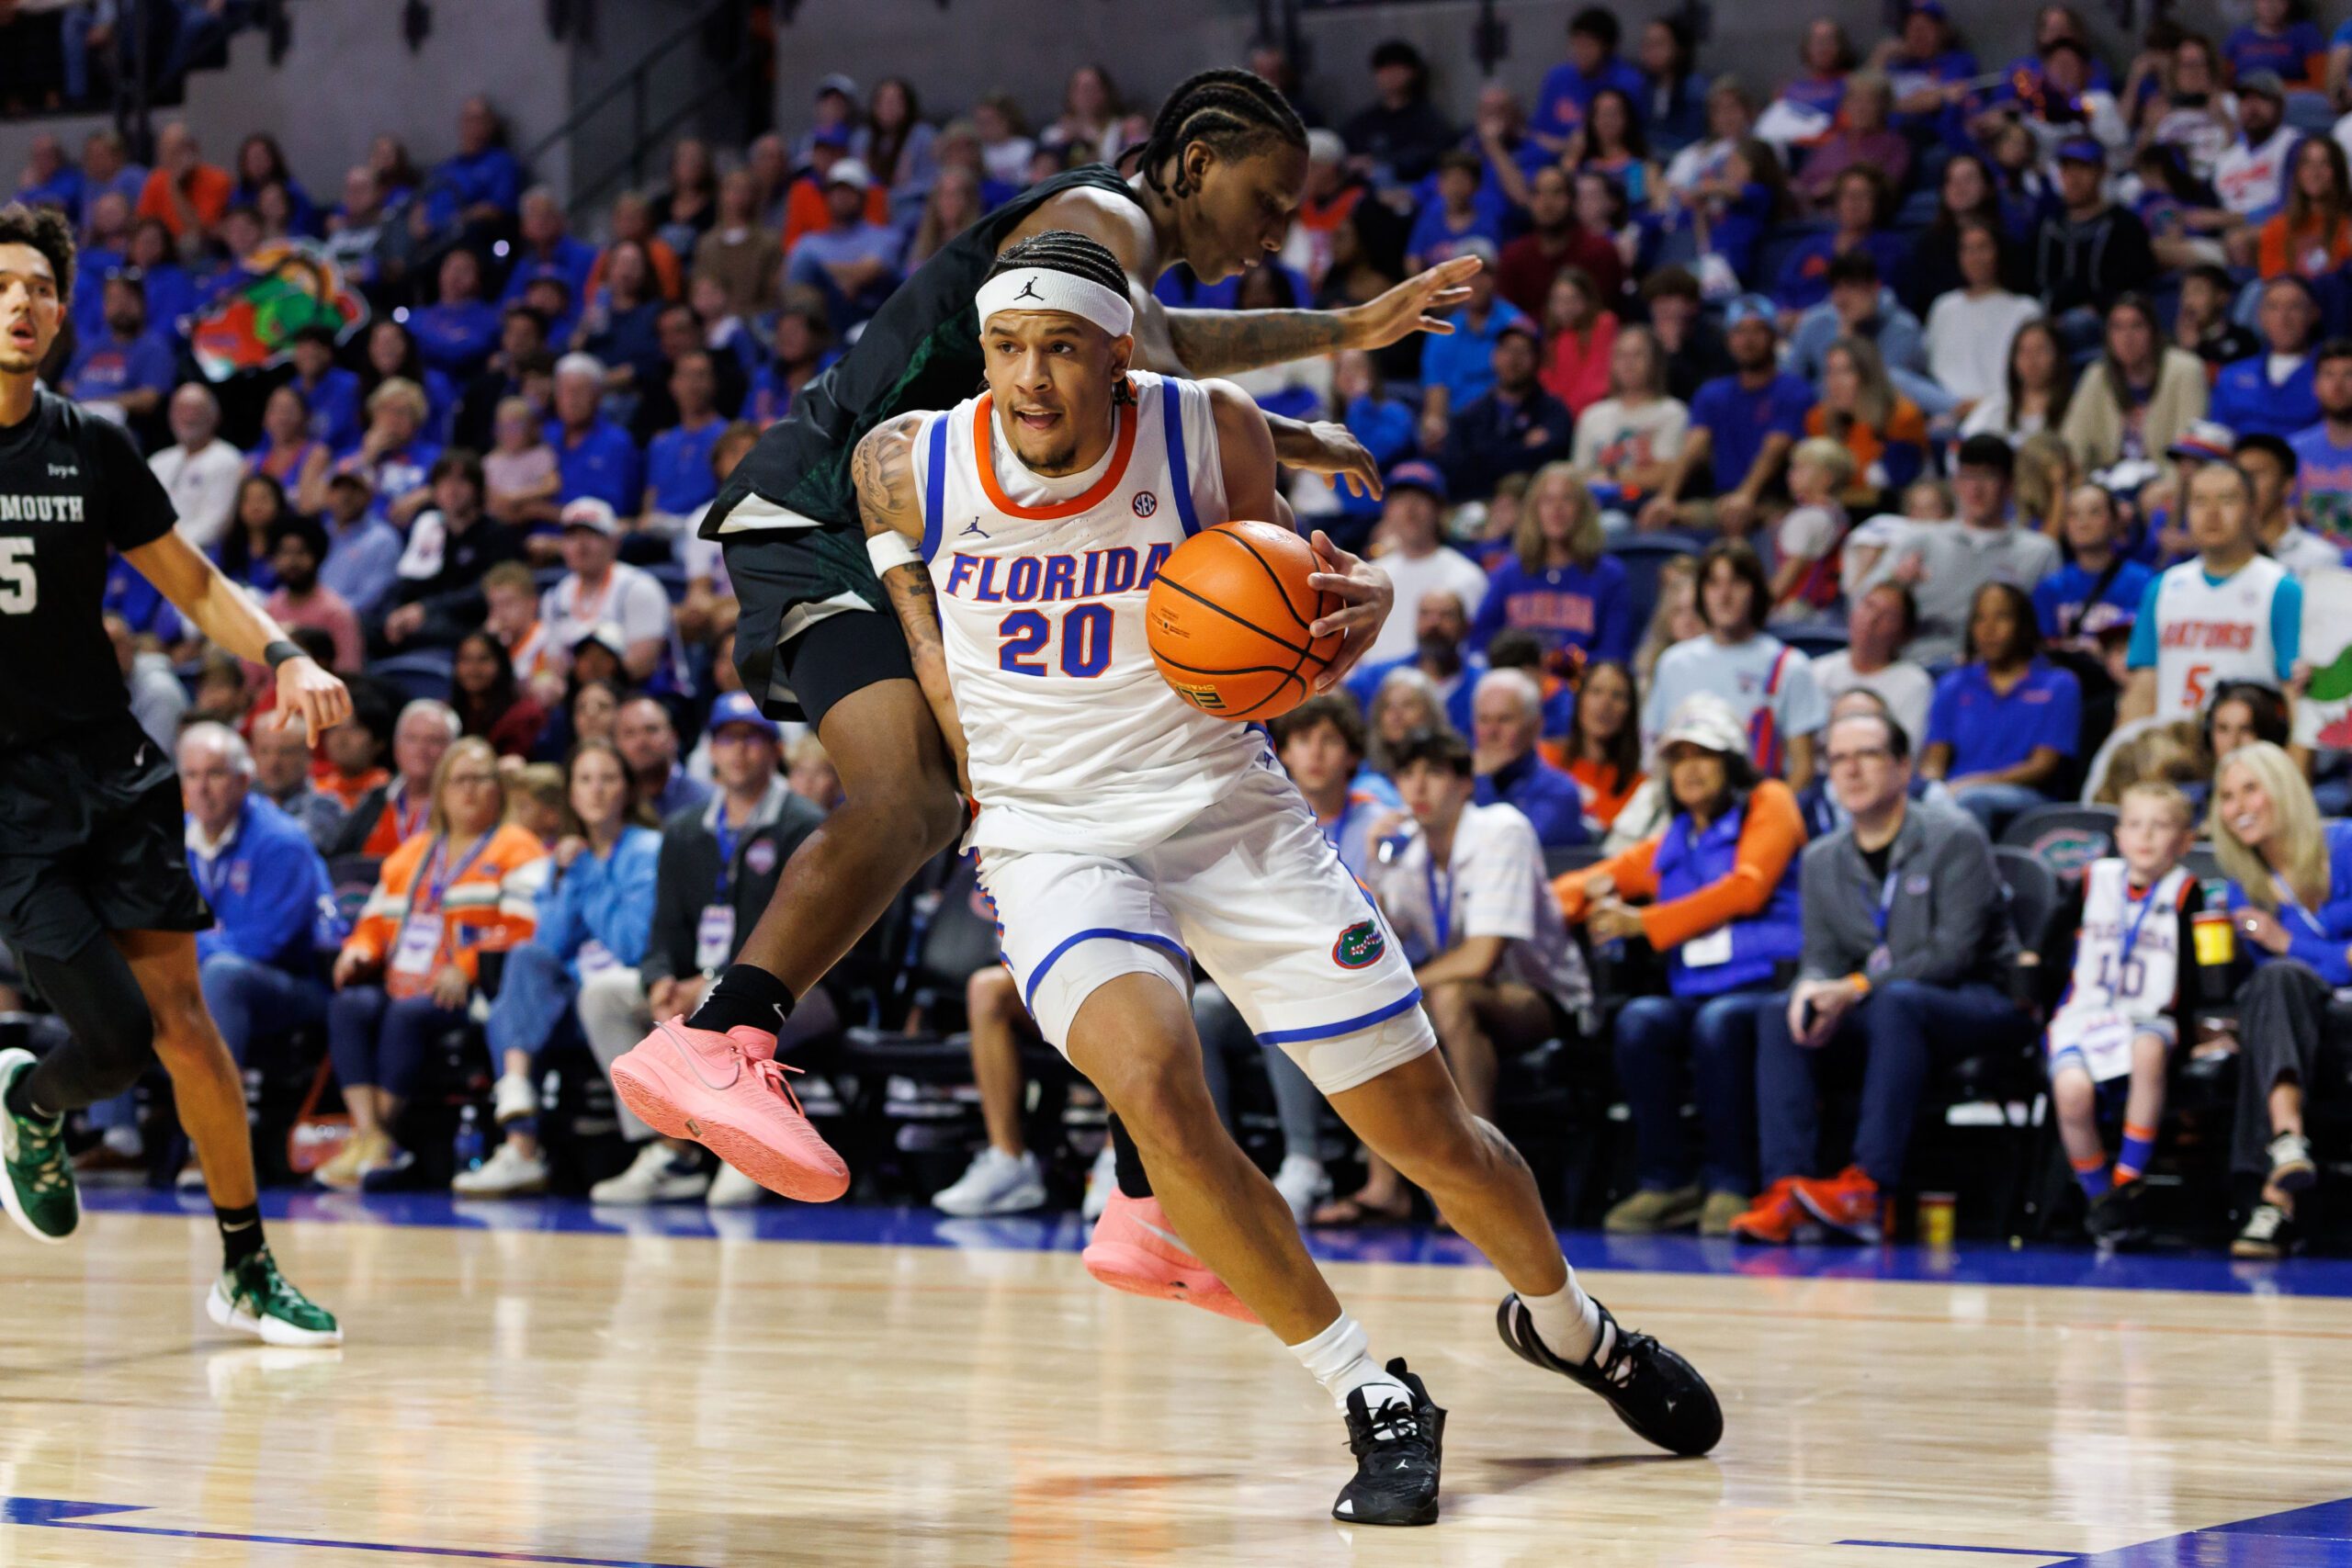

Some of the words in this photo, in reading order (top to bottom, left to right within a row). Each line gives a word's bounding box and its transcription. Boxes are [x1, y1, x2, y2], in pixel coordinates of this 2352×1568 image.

[0, 493, 84, 522] MOUTH
[1134, 493, 1156, 516] SEC
[0, 536, 37, 614] 5
[944, 542, 1172, 603] FLORIDA
[999, 603, 1114, 678] 20
[2181, 664, 2211, 708] 5
